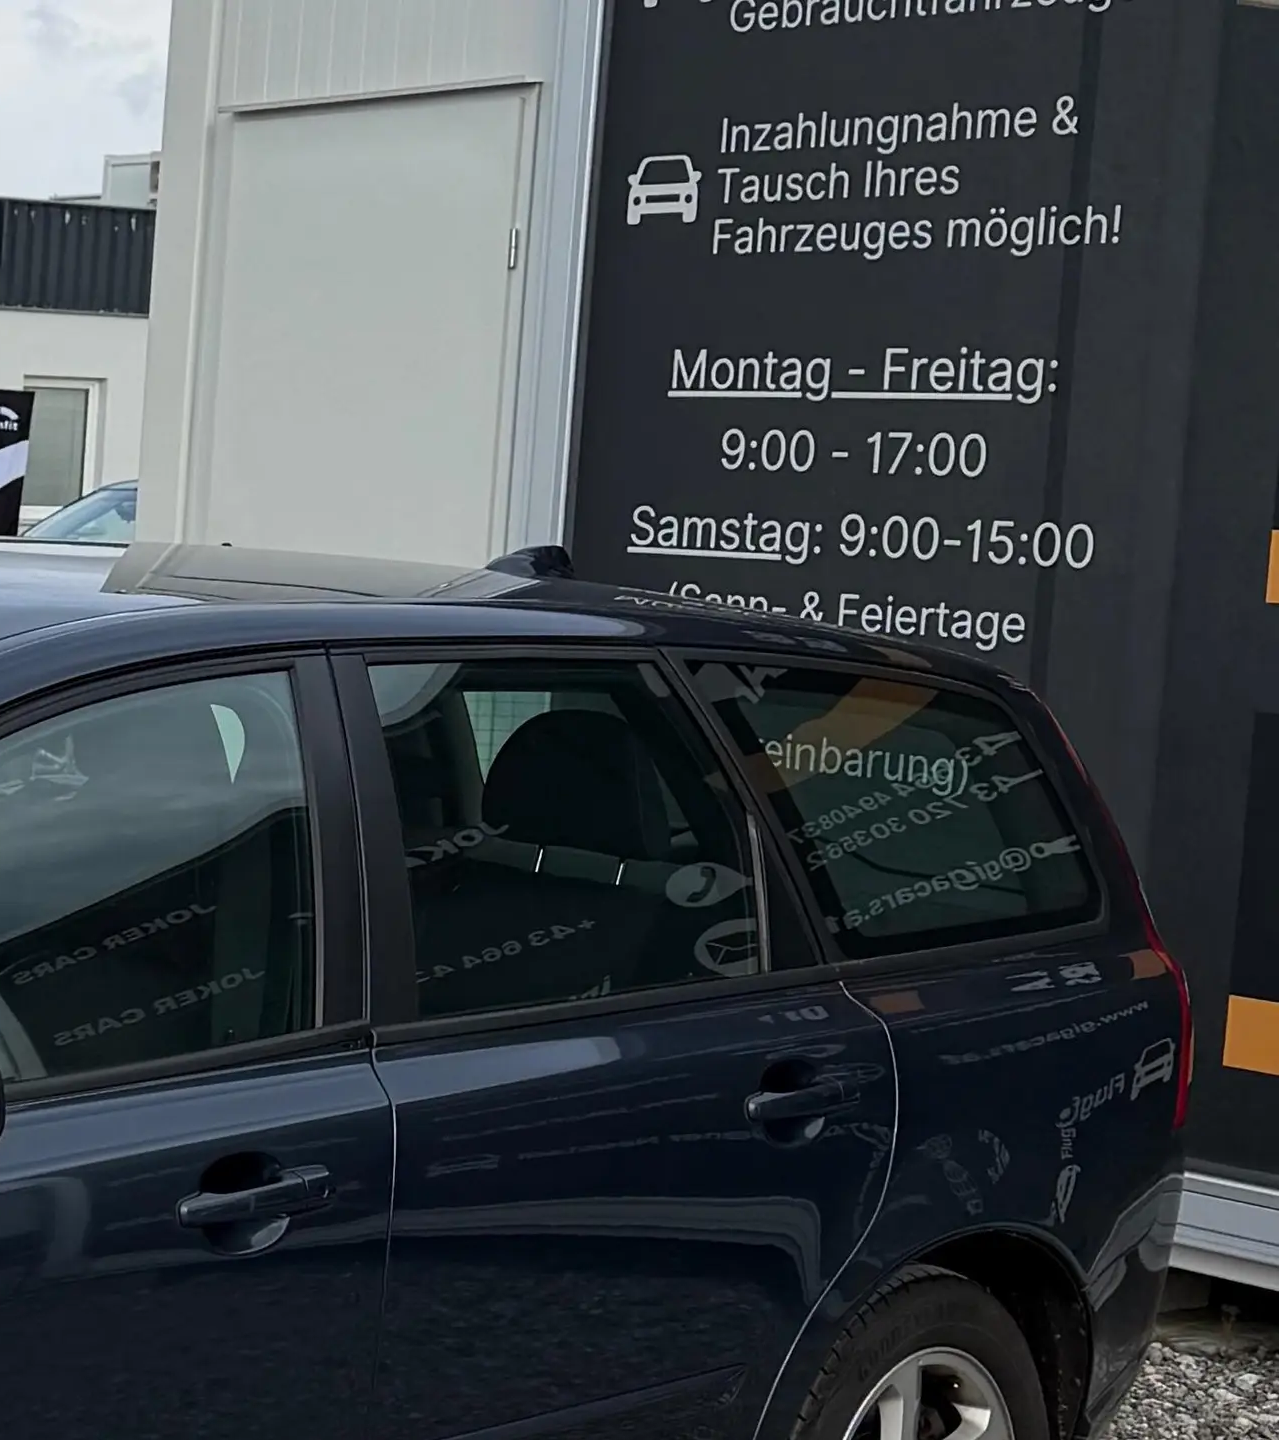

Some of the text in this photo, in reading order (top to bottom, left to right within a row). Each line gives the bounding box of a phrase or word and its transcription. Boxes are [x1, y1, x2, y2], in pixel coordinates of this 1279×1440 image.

[720, 95, 1079, 154] Inzahlungnahme &
[718, 160, 960, 204] Tausch Ihres
[712, 205, 1122, 259] Fahrzeuges möglich!
[669, 349, 831, 400] Montag
[882, 347, 1059, 403] Freitag:
[721, 428, 815, 472] 9:00
[867, 432, 987, 478] 17:00
[627, 506, 1094, 569] Samstag: 9:00-15:00
[838, 593, 1026, 651] Feiertage
